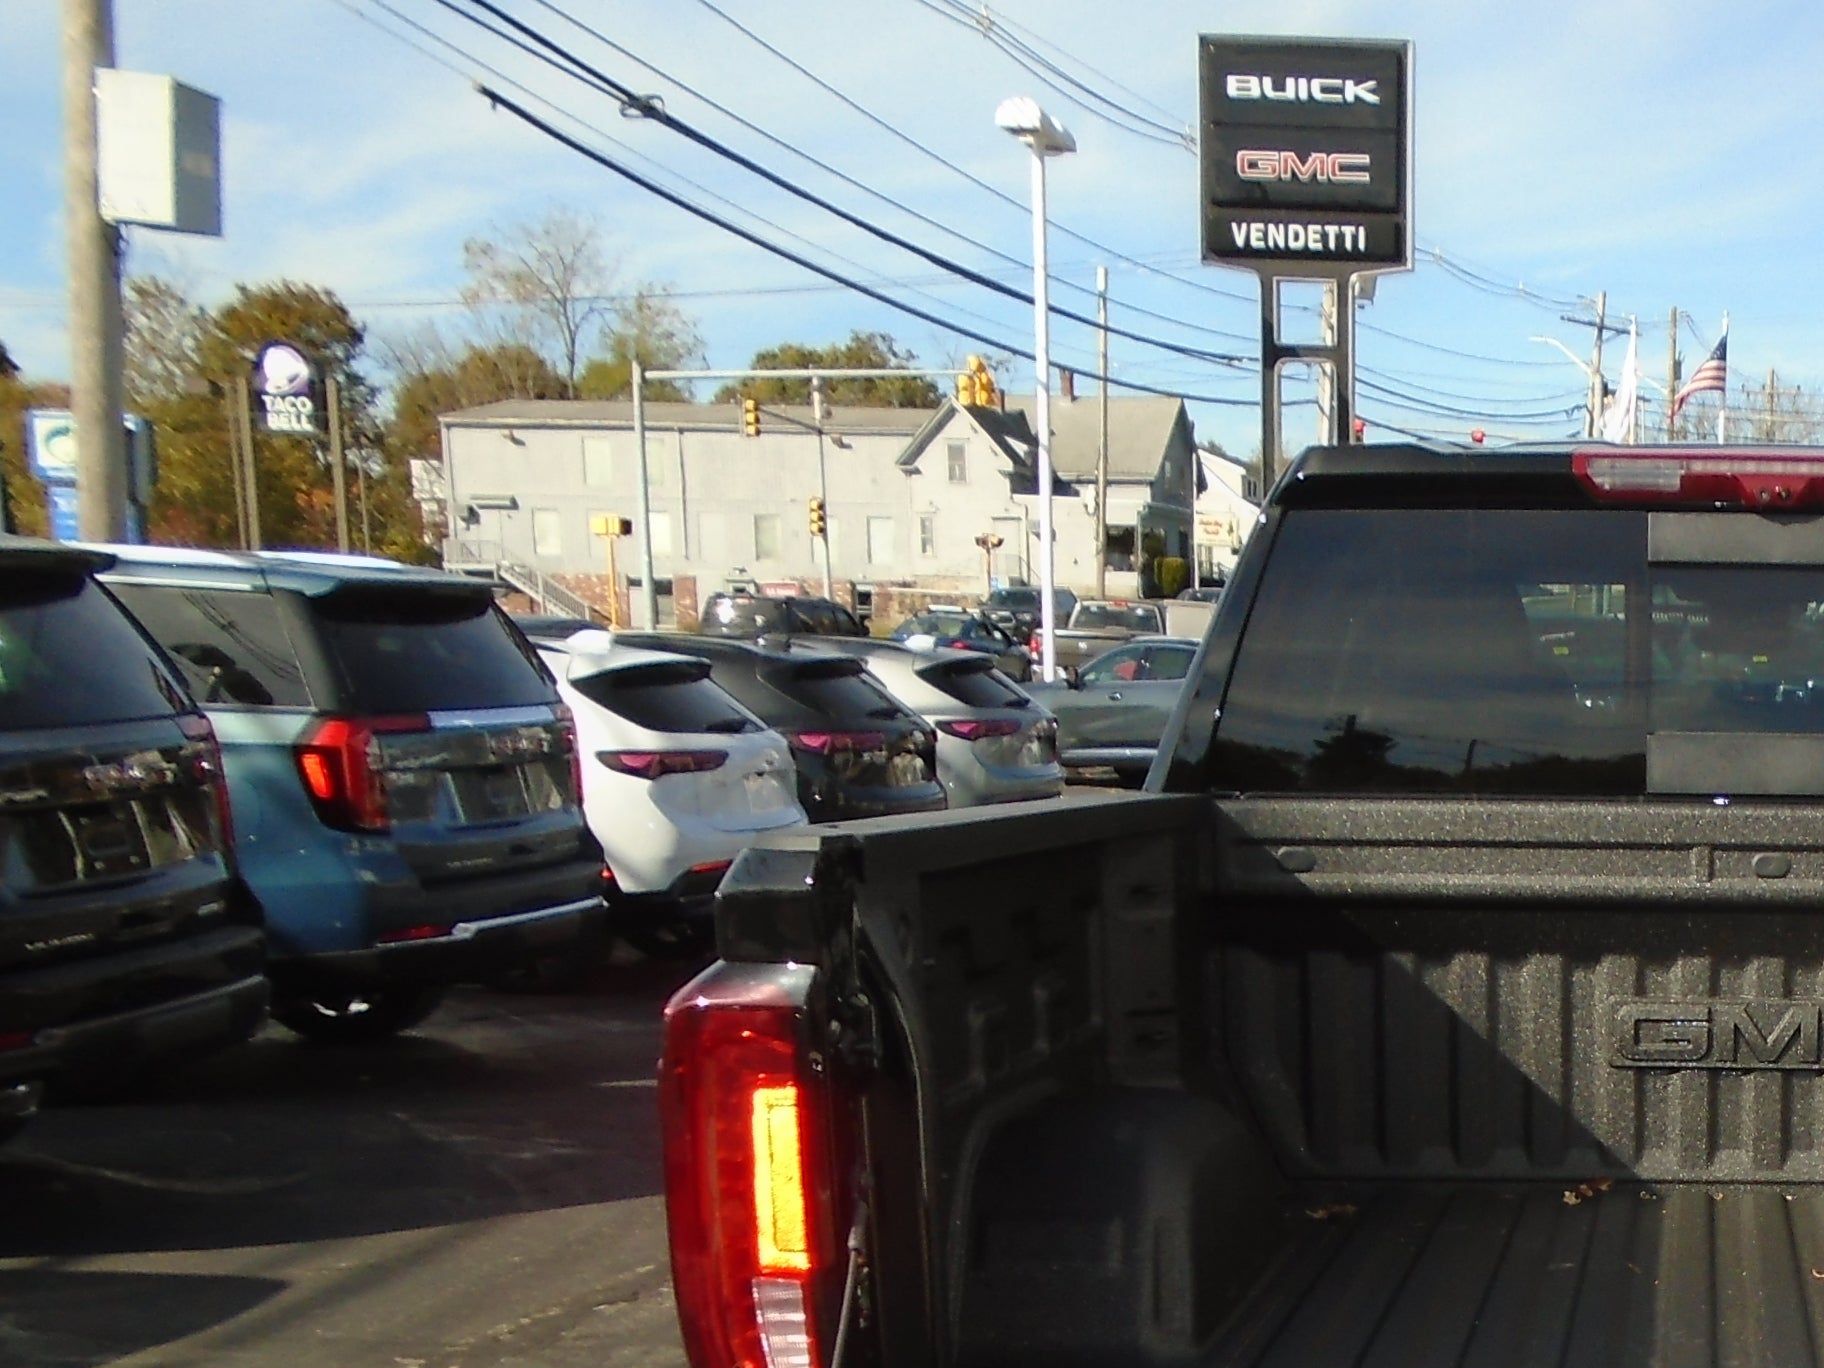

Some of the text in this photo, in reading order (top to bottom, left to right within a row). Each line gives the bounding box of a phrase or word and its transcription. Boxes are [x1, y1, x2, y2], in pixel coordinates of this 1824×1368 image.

[1226, 74, 1380, 104] BUICK
[1236, 150, 1370, 184] GMC
[1231, 222, 1366, 252] VENDETTI
[261, 394, 314, 415] TACO
[267, 413, 315, 432] BELL
